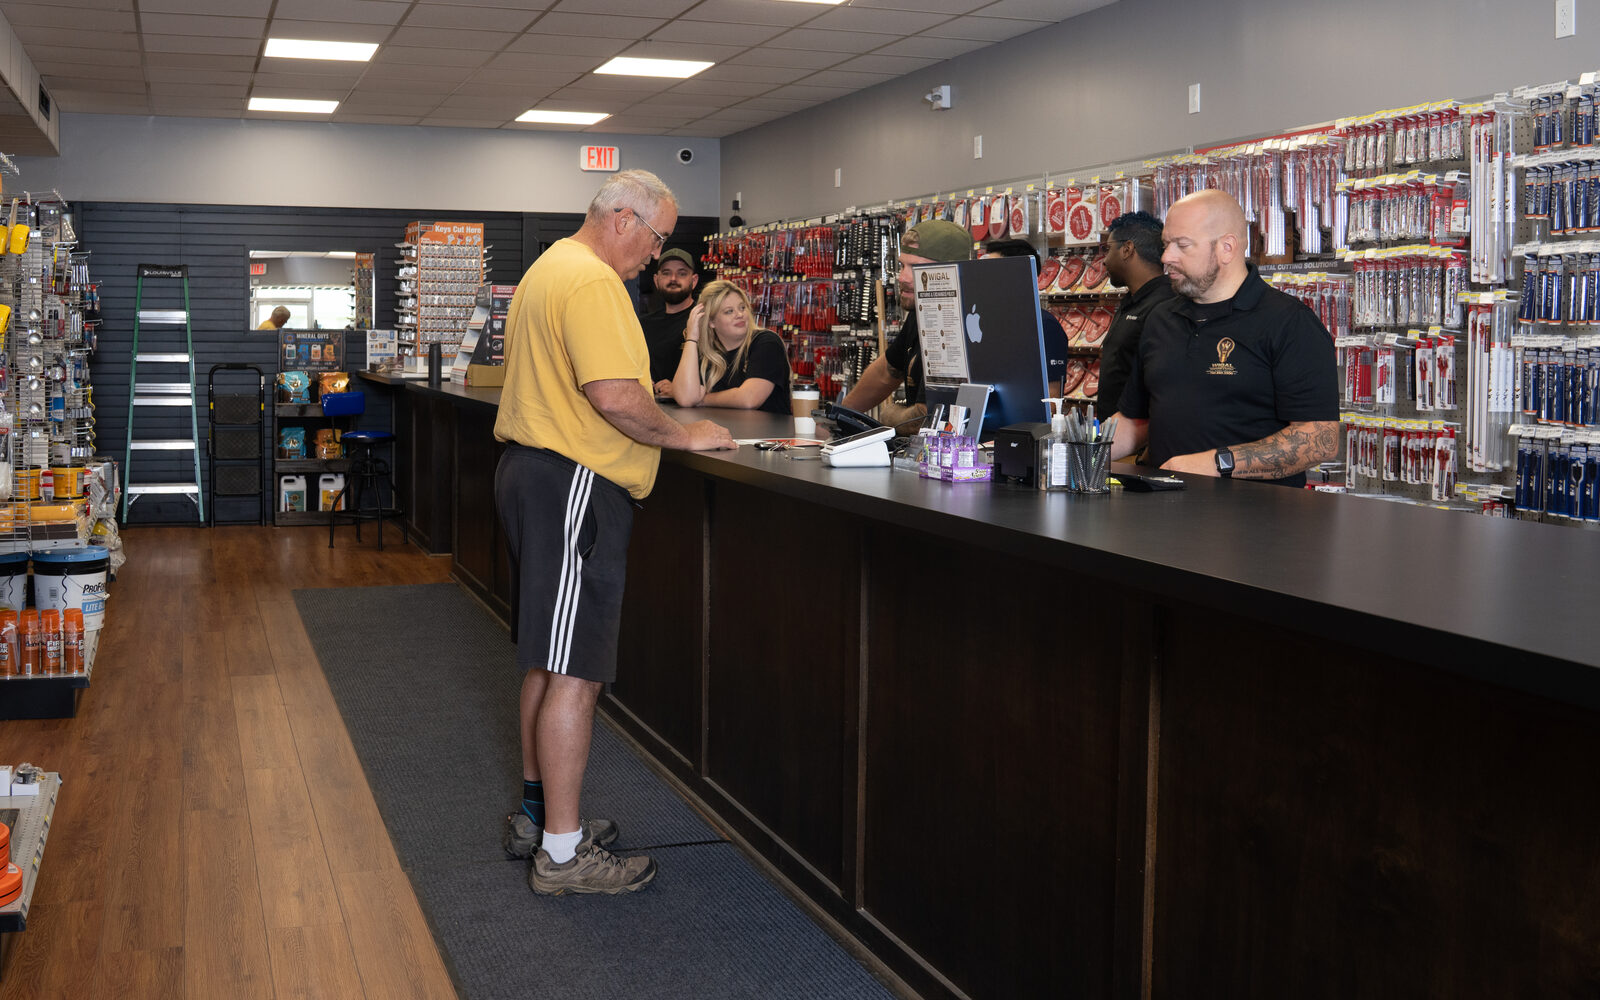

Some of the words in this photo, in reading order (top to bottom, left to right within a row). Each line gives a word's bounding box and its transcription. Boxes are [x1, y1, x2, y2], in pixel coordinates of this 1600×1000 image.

[587, 146, 615, 169] EXIT
[435, 225, 451, 234] Keys
[466, 226, 481, 234] Here
[1304, 261, 1338, 269] SOLUTIONS
[928, 272, 950, 281] WIGAL
[86, 602, 99, 612] LITE
